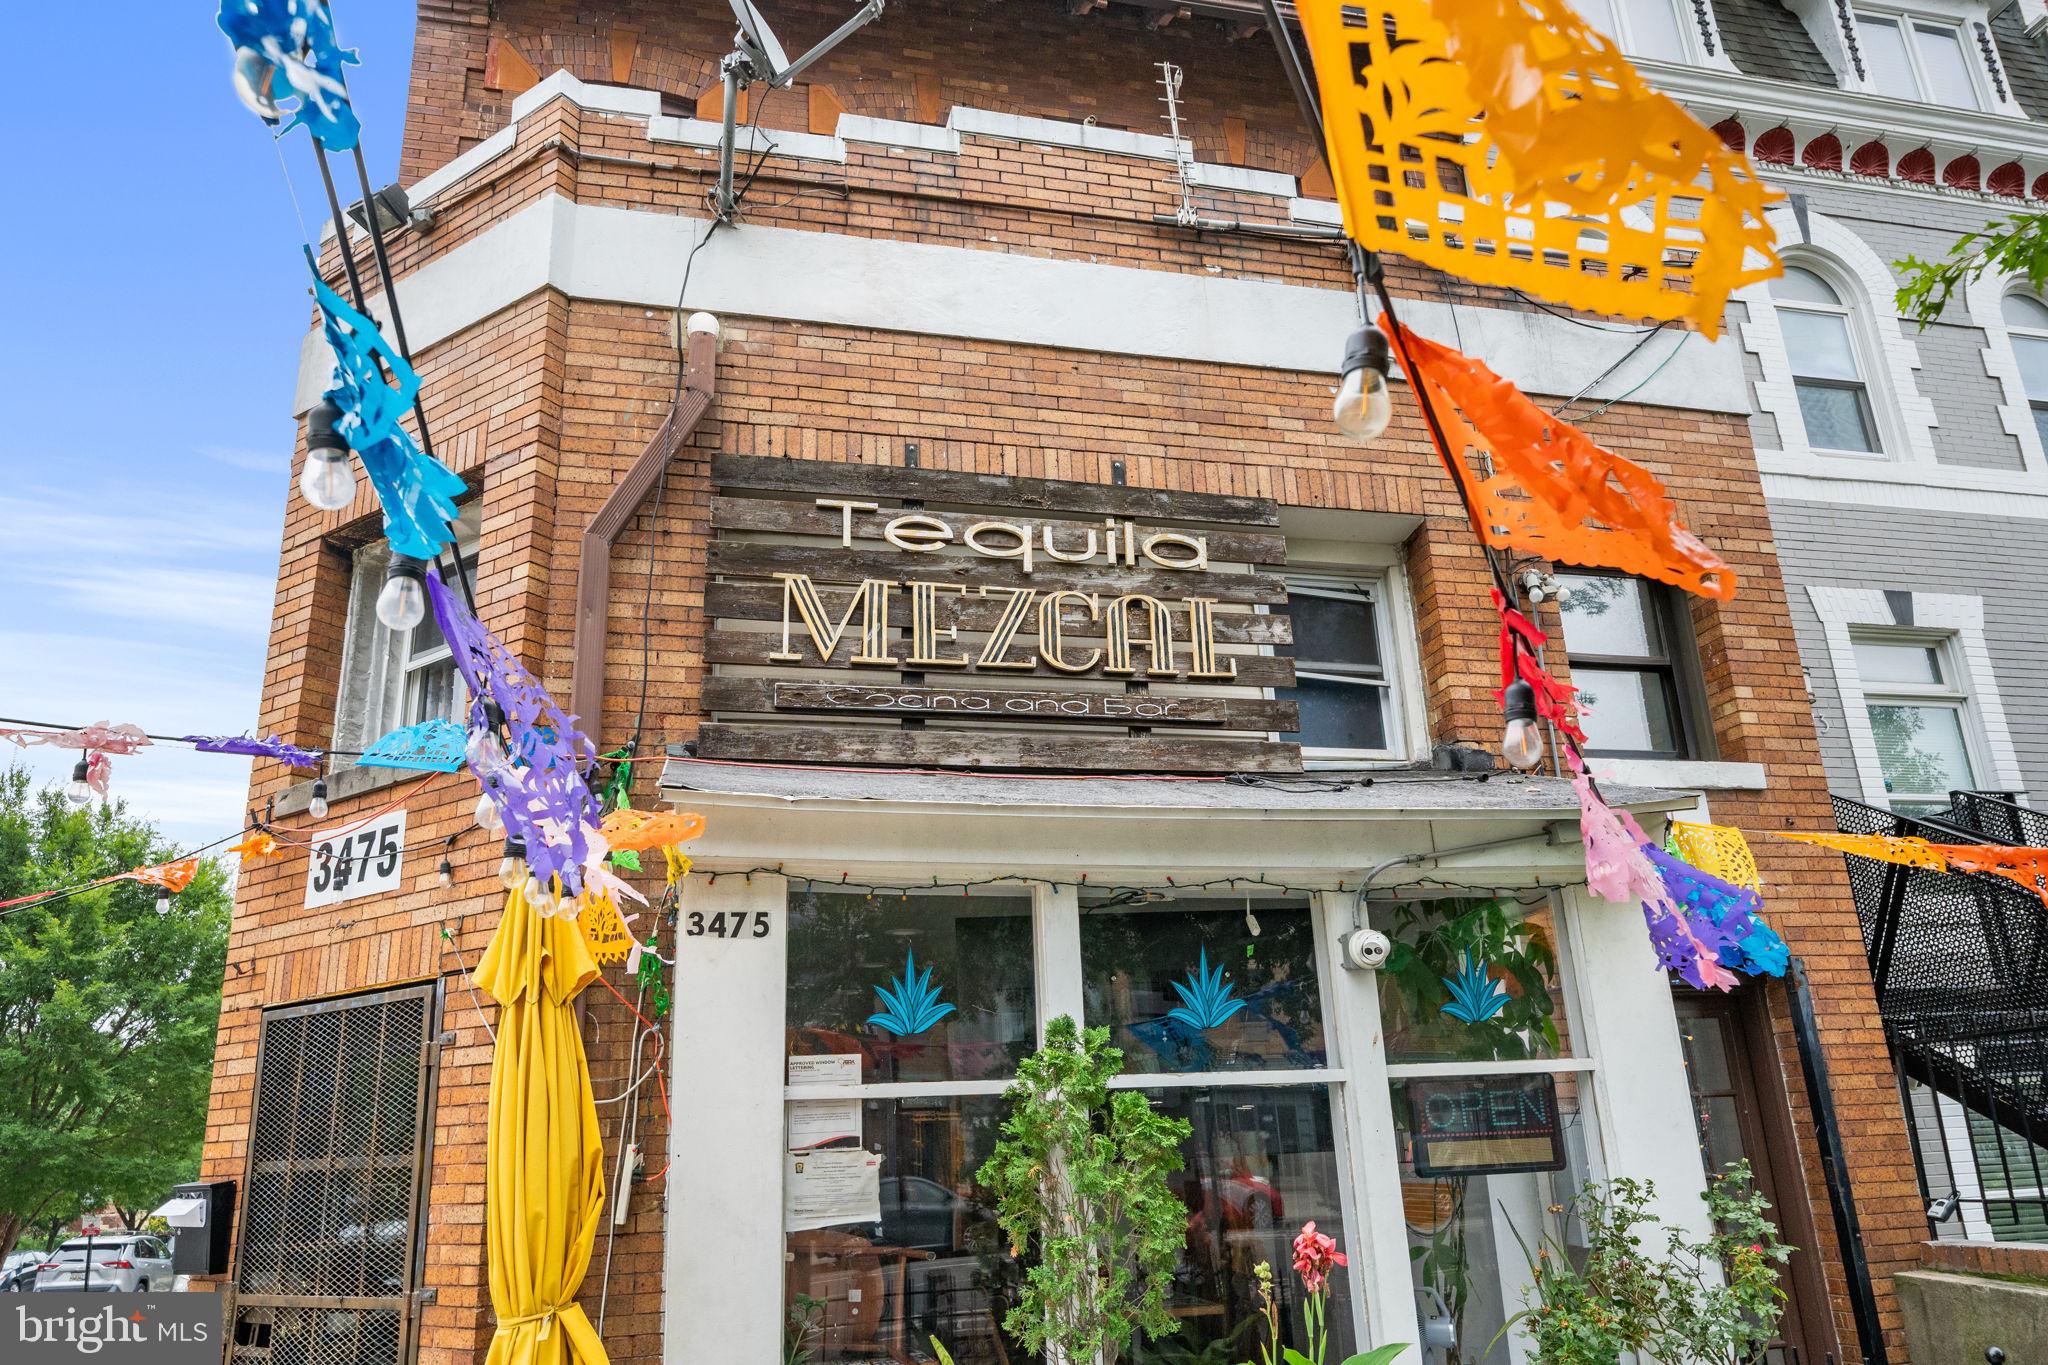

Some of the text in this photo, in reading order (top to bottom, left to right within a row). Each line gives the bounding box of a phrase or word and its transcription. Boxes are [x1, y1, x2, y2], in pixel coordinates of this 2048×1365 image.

[815, 498, 1208, 573] Tequila
[769, 572, 1237, 680] MEZCAL
[1005, 698, 1090, 714] and
[313, 823, 400, 894] 3475
[686, 911, 771, 939] 3475
[1425, 1089, 1547, 1128] OPEN
